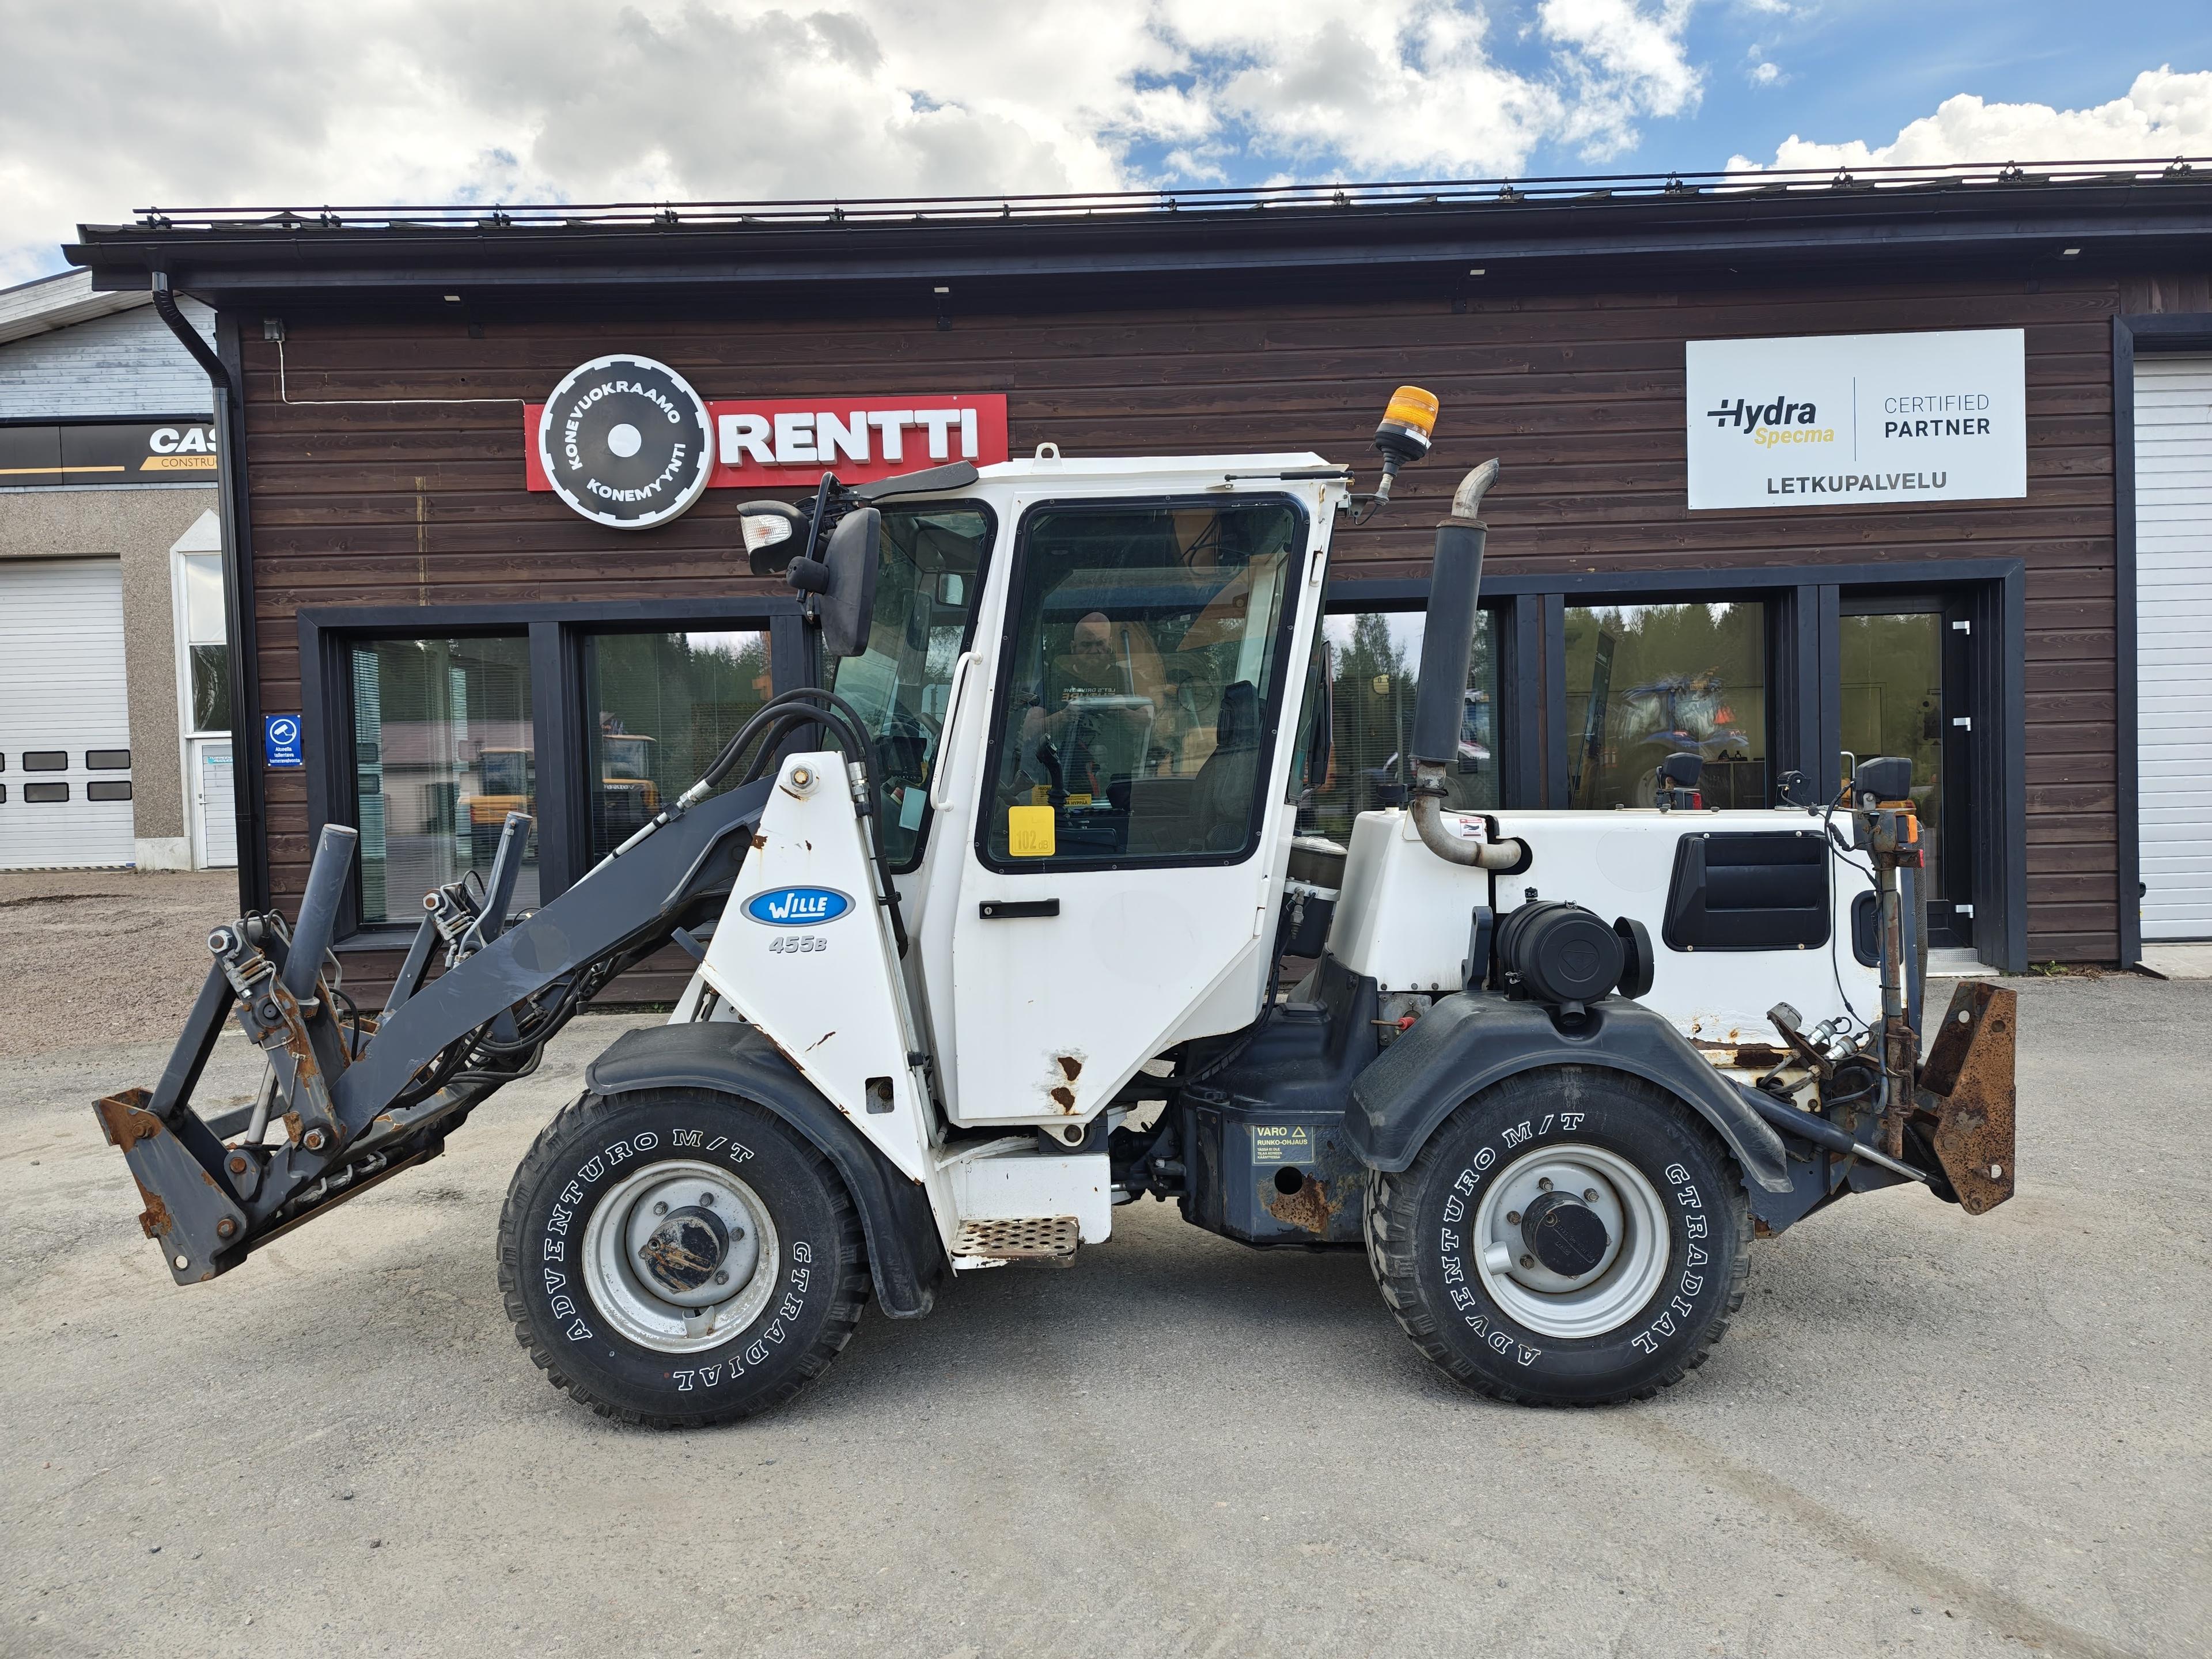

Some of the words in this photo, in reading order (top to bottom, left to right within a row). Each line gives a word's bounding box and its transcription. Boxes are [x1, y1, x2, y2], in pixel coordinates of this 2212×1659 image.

[1707, 396, 1816, 434] Hydra
[1885, 395, 1990, 414] CERTIFIED
[564, 380, 680, 471] KONEVUOKRAAMO
[1885, 418, 1990, 438] PARTNER
[718, 408, 979, 467] RENTTI
[1754, 427, 1834, 448] Specma
[161, 459, 217, 467] CONSTRU
[586, 442, 686, 502] KONEMYYNTI
[1767, 471, 1948, 494] LETKUPALVELU
[1017, 830, 1036, 850] 102
[1039, 840, 1048, 850] dB
[769, 935, 827, 953] 455B
[1257, 1127, 1287, 1136] VARO
[544, 1131, 659, 1342] ADVENTURO
[673, 1129, 753, 1164] M/T
[1441, 1147, 1541, 1366] ADVENTURO
[1502, 1113, 1584, 1148] M/T
